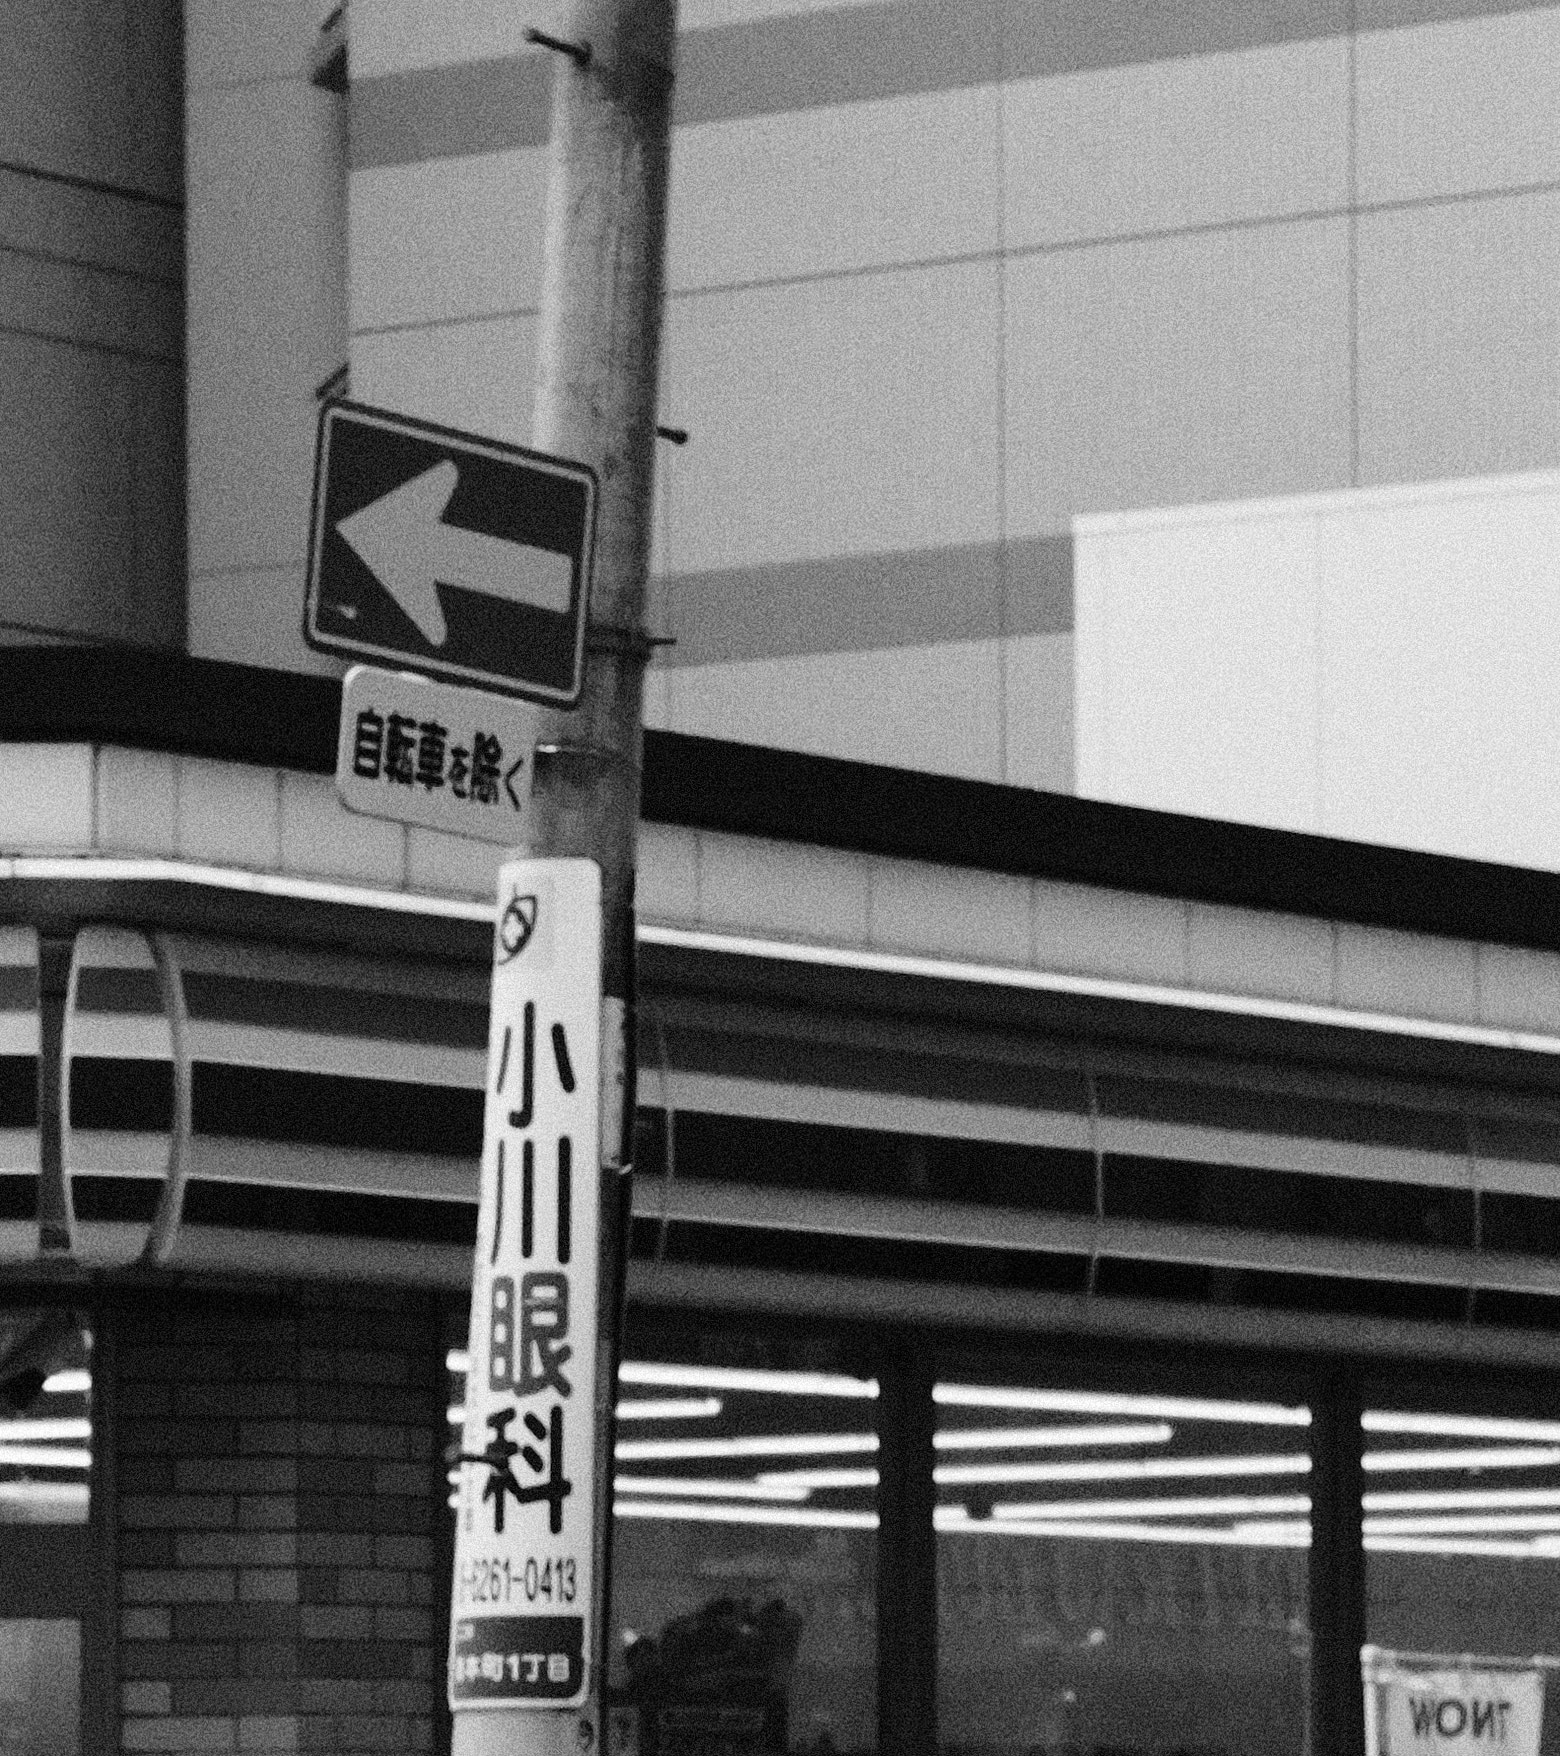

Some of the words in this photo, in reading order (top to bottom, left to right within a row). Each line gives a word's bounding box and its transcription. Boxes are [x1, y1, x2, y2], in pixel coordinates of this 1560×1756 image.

[353, 706, 525, 813] 自転車を除く
[486, 1000, 577, 1536] 小川眼科
